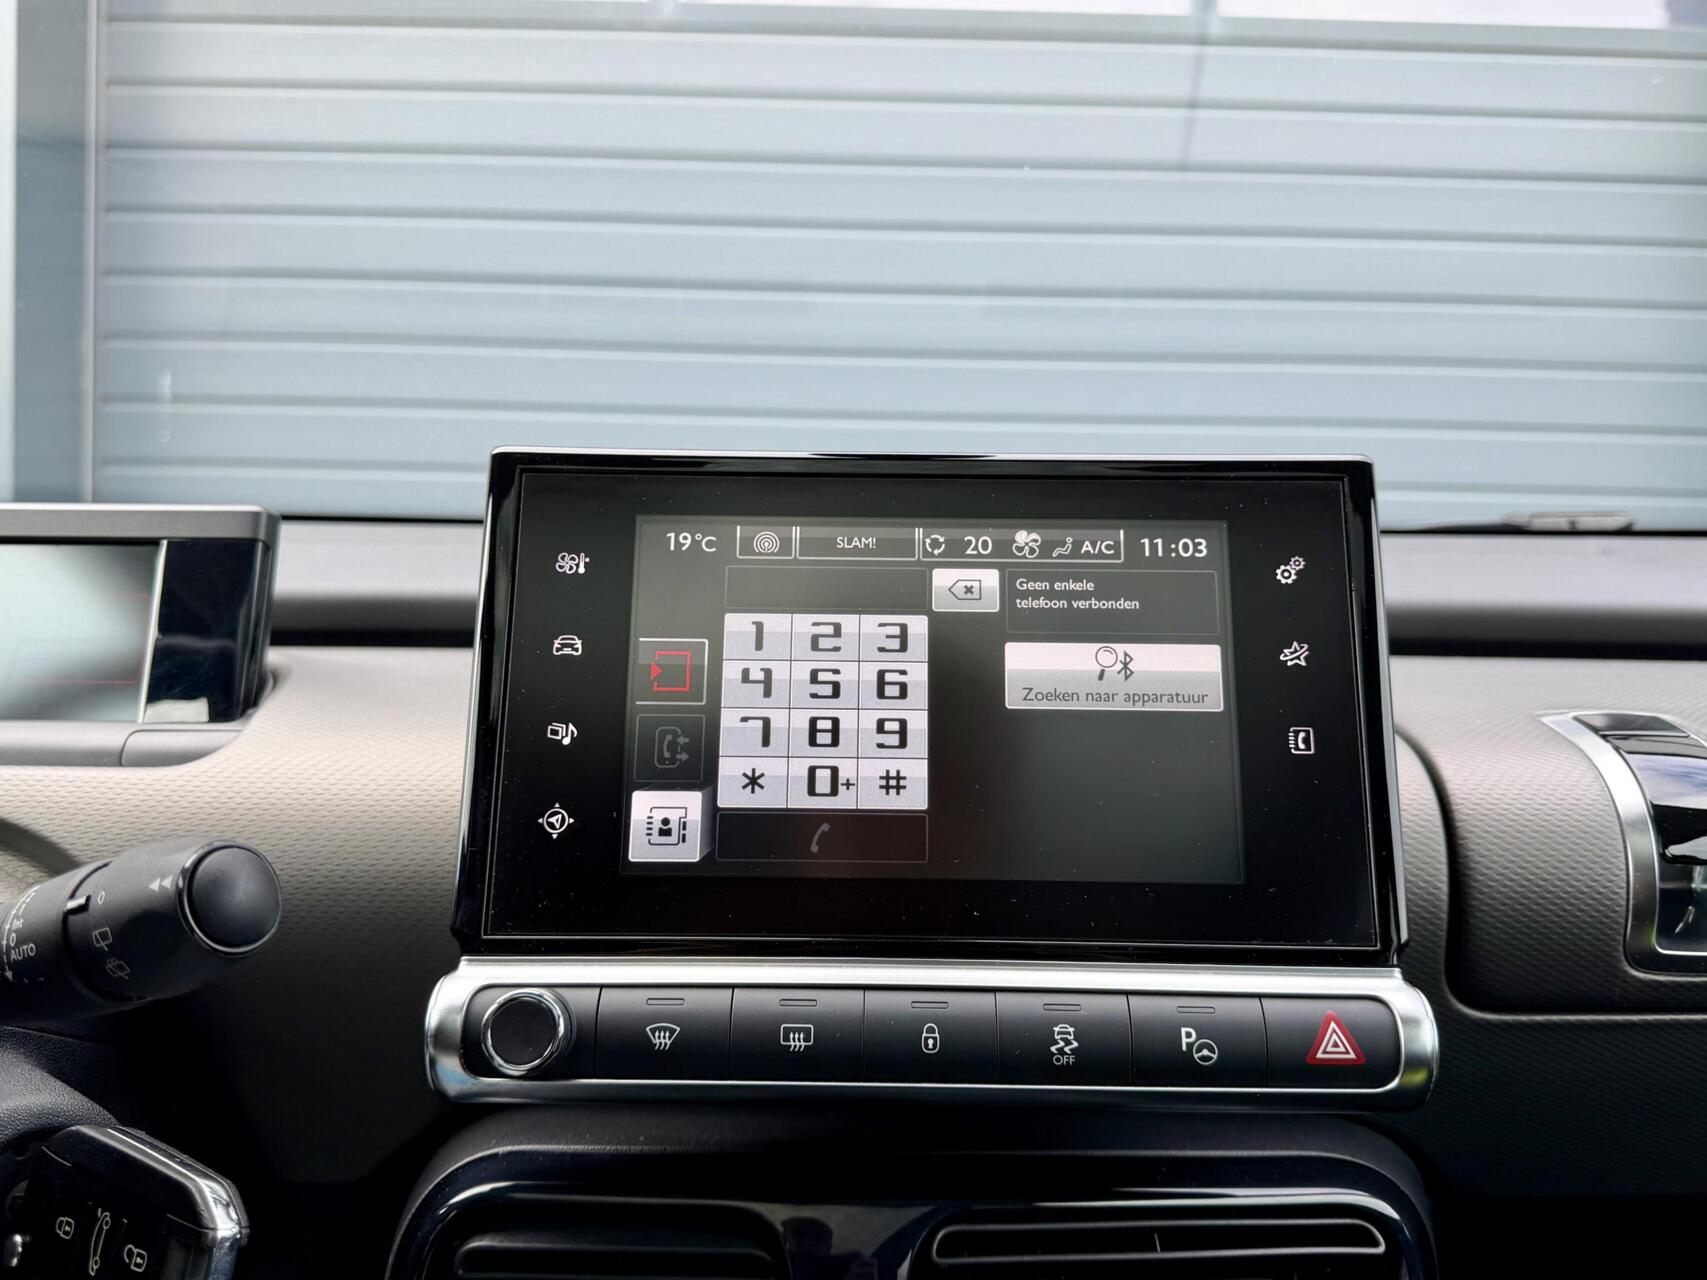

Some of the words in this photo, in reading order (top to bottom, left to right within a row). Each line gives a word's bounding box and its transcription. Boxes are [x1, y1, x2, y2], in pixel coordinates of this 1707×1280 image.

[666, 532, 717, 552] 19°C
[836, 536, 876, 549] SLAM!
[964, 536, 992, 555] 20
[1081, 540, 1115, 555] A/C
[1140, 538, 1208, 557] 11:03
[1016, 578, 1050, 591] Geen
[1054, 579, 1095, 591] enkele
[1016, 597, 1067, 609] telefoon
[1072, 597, 1140, 610] verbonden
[751, 621, 764, 651] 1
[811, 622, 842, 652] 2
[877, 622, 908, 653] 3
[741, 667, 773, 698] 4
[809, 668, 841, 699] 5
[876, 669, 908, 700] 6
[1022, 687, 1079, 702] Zoeken
[1085, 690, 1118, 703] naar
[1123, 691, 1208, 707] apparatuur
[739, 716, 771, 747] 7
[808, 716, 840, 747] 8
[876, 718, 908, 749] 9
[10, 943, 36, 961] AUTO
[1181, 1027, 1196, 1052] P
[1053, 1055, 1076, 1066] OFF
